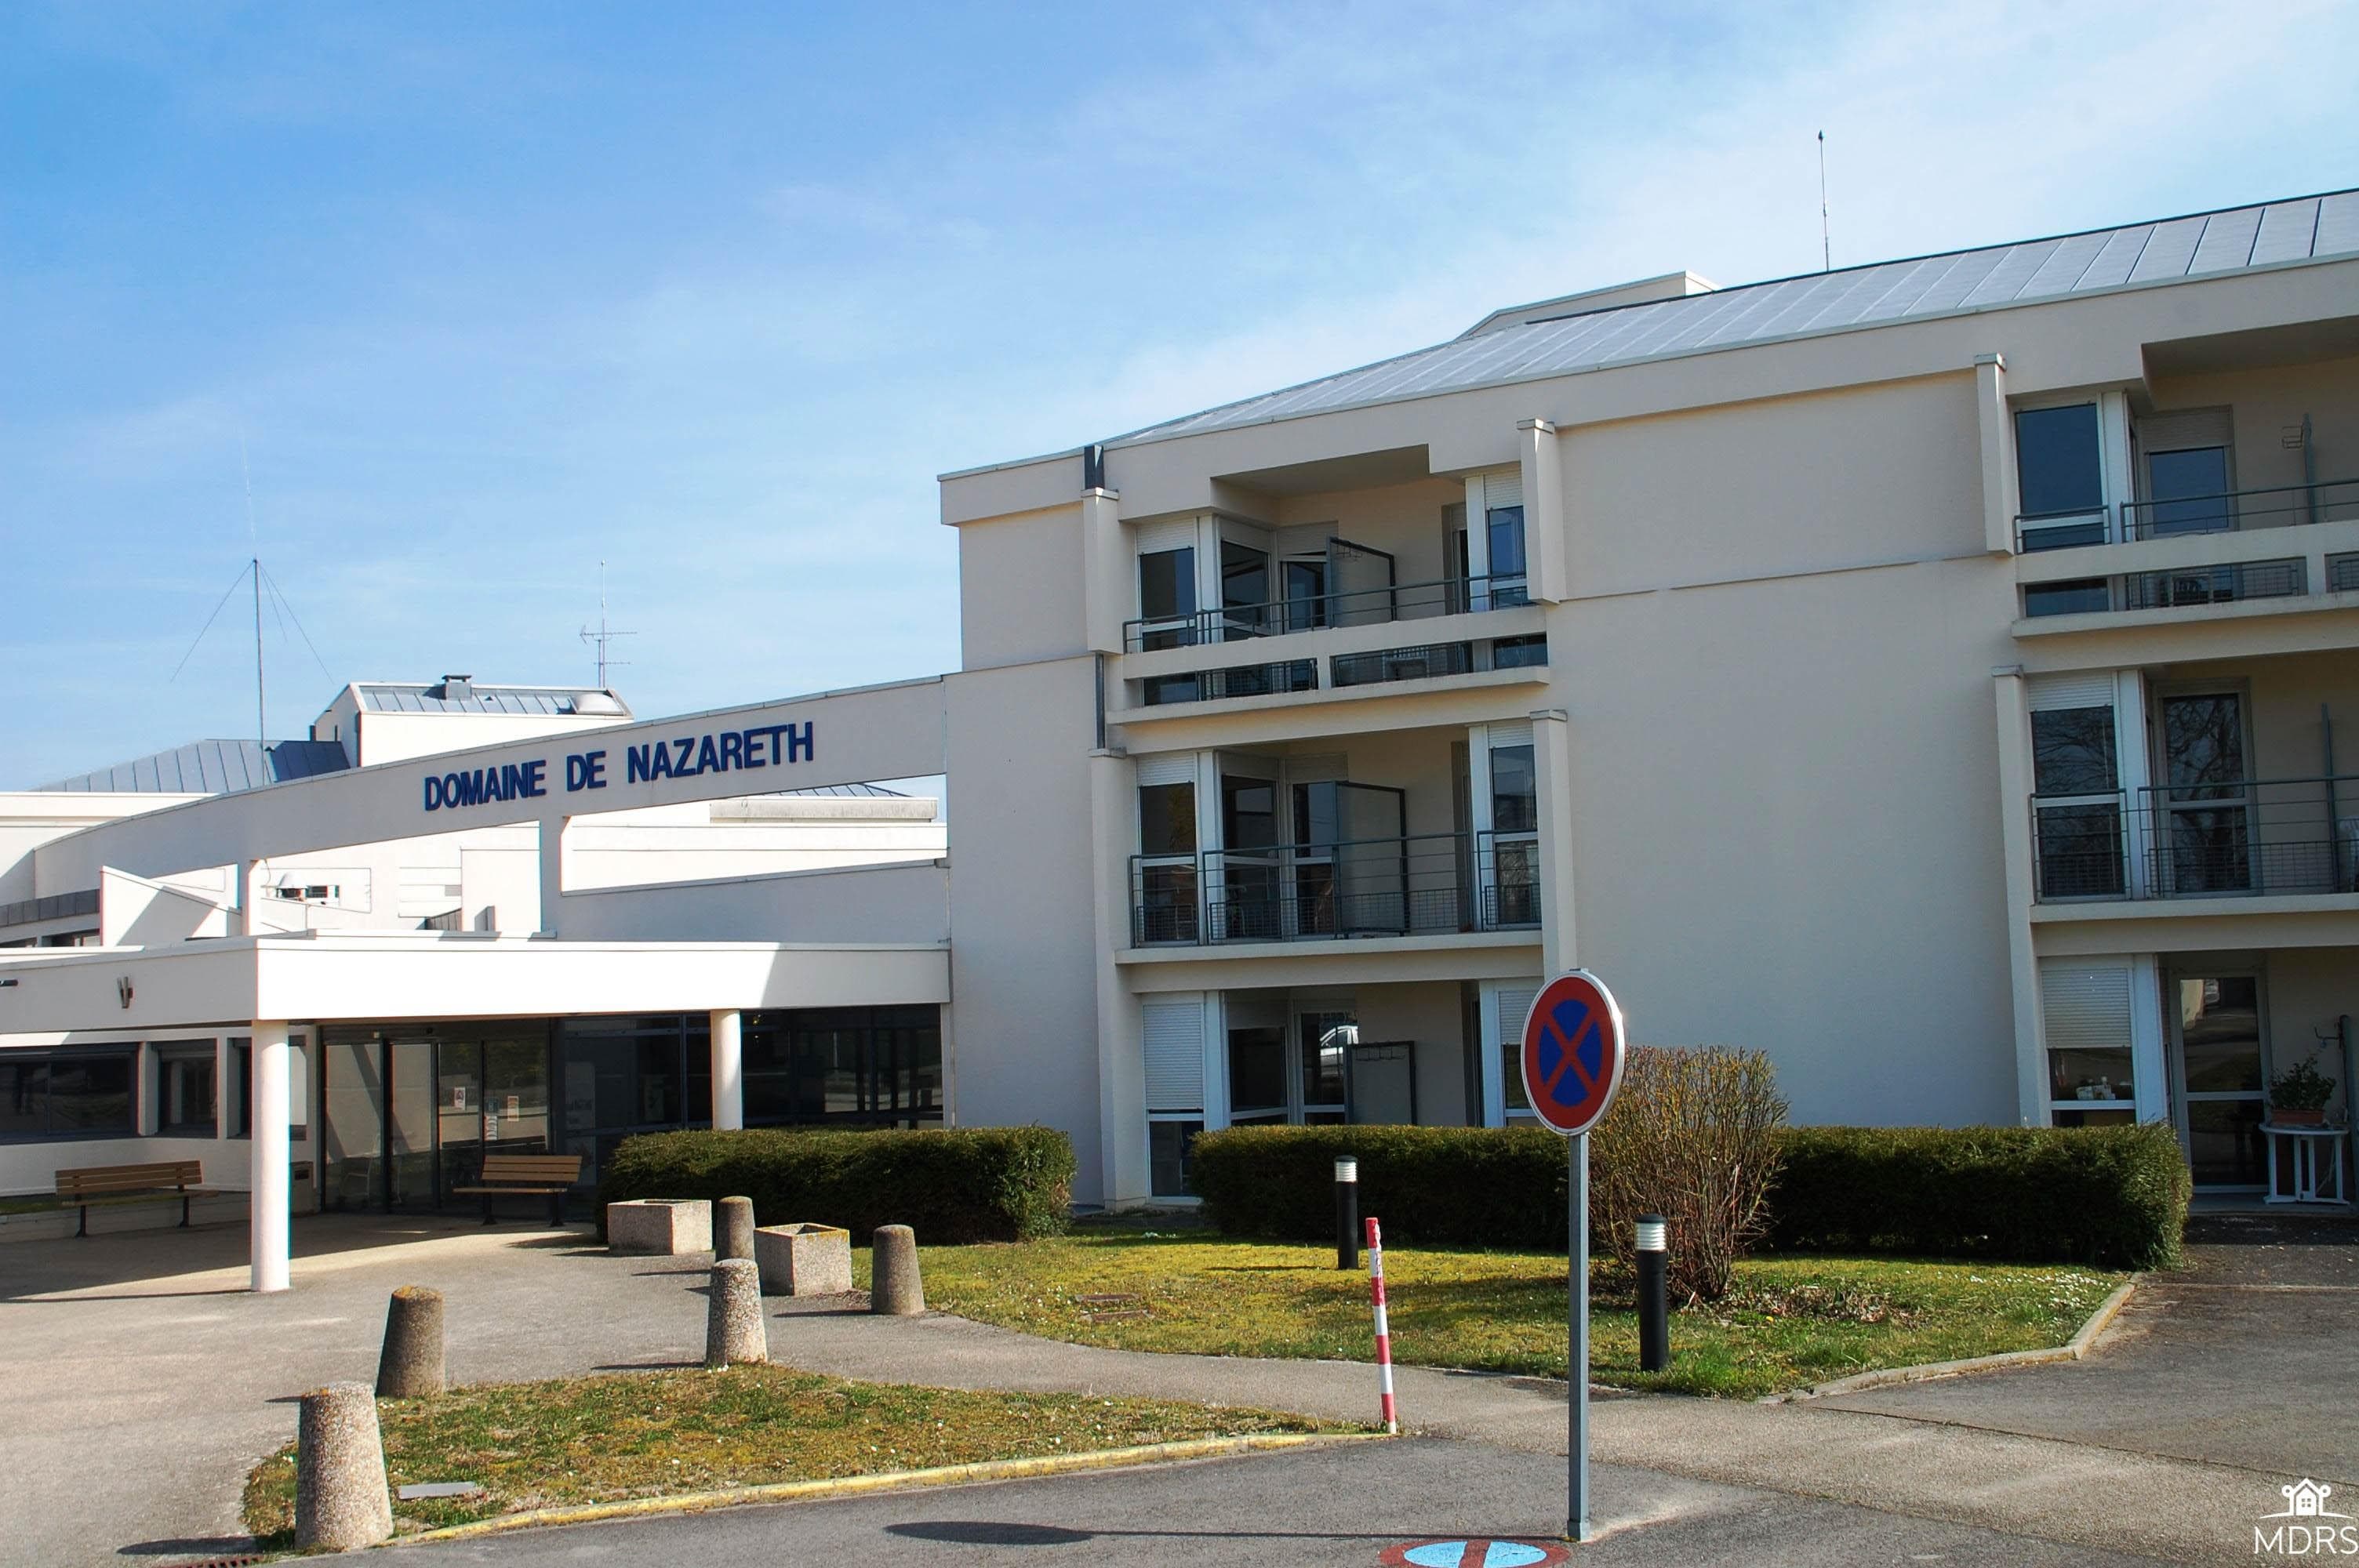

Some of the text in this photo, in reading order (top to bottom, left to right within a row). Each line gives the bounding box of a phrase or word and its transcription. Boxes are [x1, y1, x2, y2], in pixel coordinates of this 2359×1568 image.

[424, 722, 813, 811] DOMAINE DE NAZARETH
